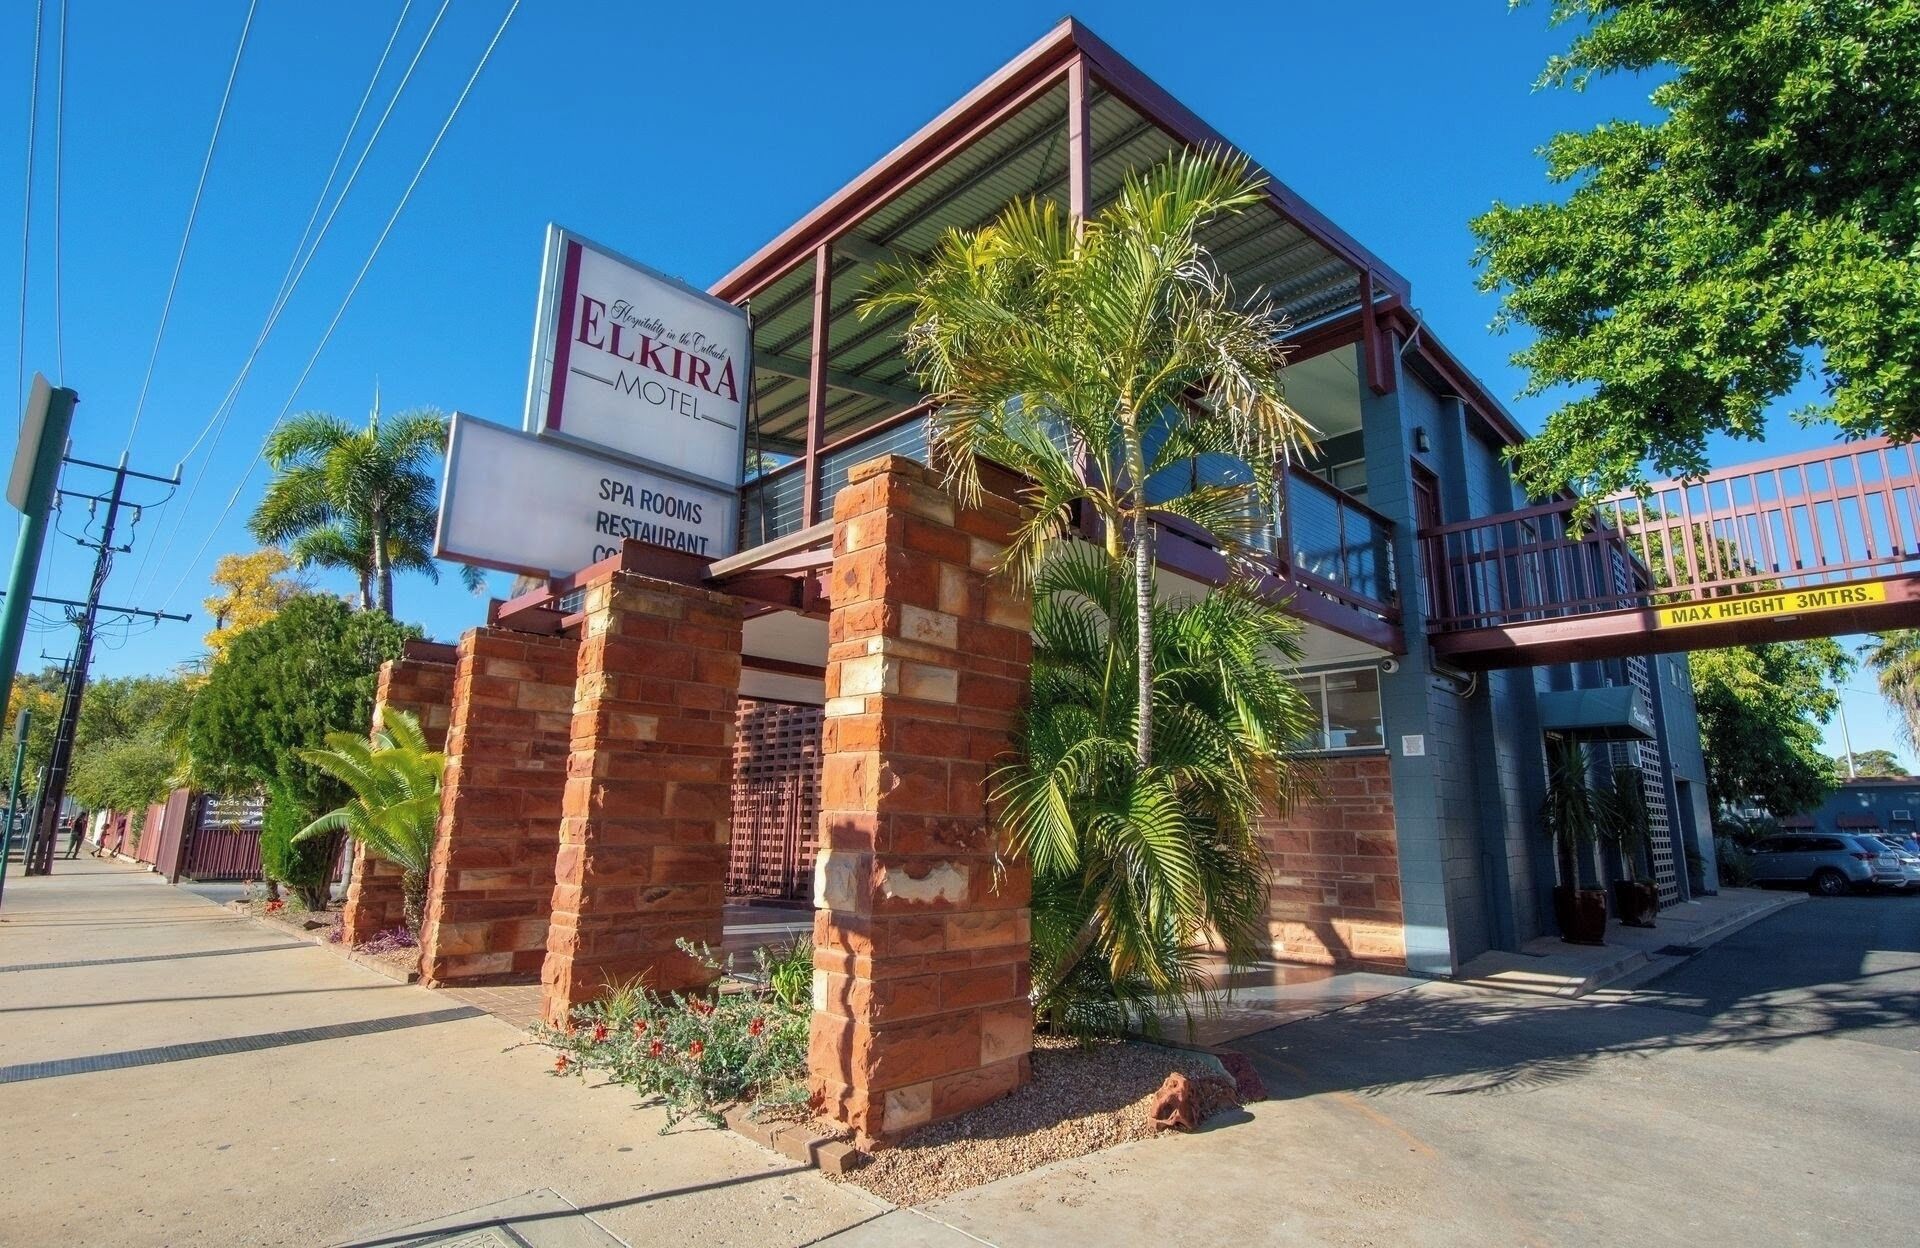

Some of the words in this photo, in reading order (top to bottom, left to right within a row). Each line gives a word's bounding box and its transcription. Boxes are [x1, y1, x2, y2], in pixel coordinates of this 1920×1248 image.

[575, 294, 740, 403] ELKIRA
[610, 299, 666, 340] Hospitality
[667, 329, 677, 339] in
[679, 332, 690, 346] the
[692, 331, 727, 361] Outback
[614, 370, 703, 421] MOTEL
[598, 478, 634, 507] SPA
[640, 488, 703, 525] ROOMS
[596, 510, 709, 556] RESTAURANT
[1671, 606, 1713, 624] MAX
[1718, 596, 1786, 618] HEIGHT
[1796, 587, 1874, 609] 3MTRS.
